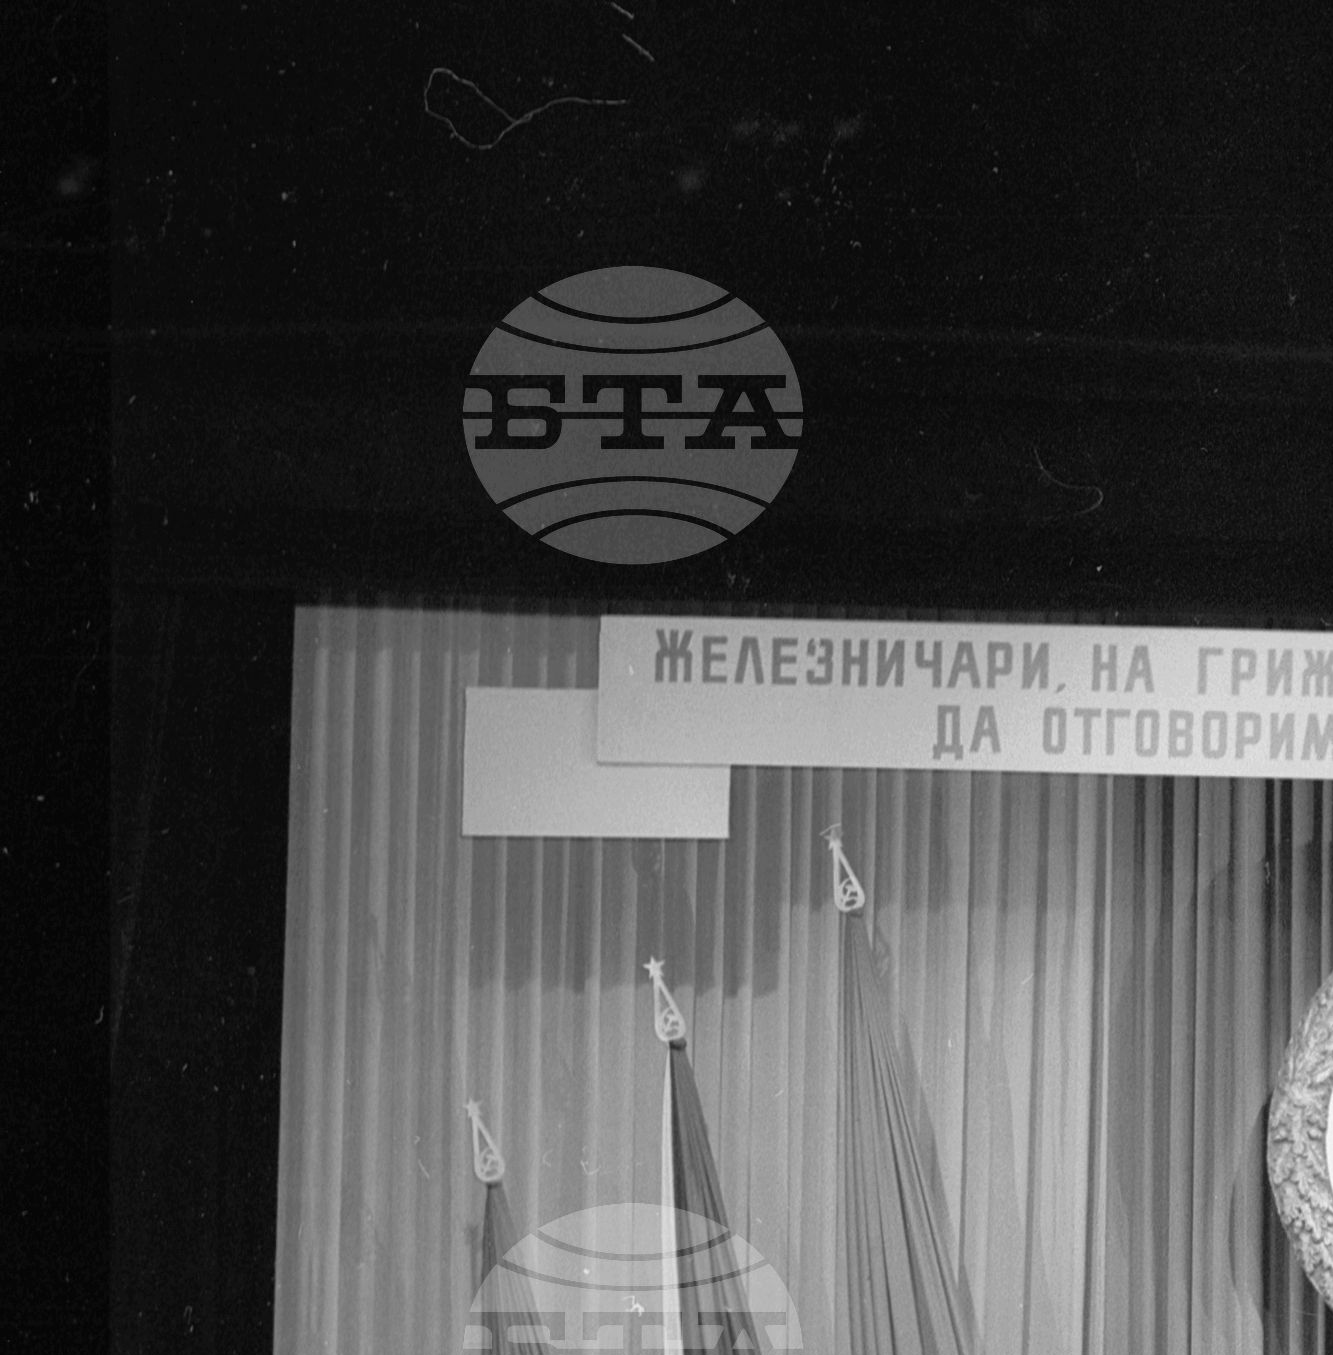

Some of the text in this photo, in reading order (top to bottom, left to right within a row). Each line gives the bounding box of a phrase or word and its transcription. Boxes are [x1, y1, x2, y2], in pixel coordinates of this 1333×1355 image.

[655, 628, 1067, 694] ЖЕЛЕЗНИЧАРИ,
[1092, 643, 1155, 694] НА
[932, 704, 1002, 760] ДА
